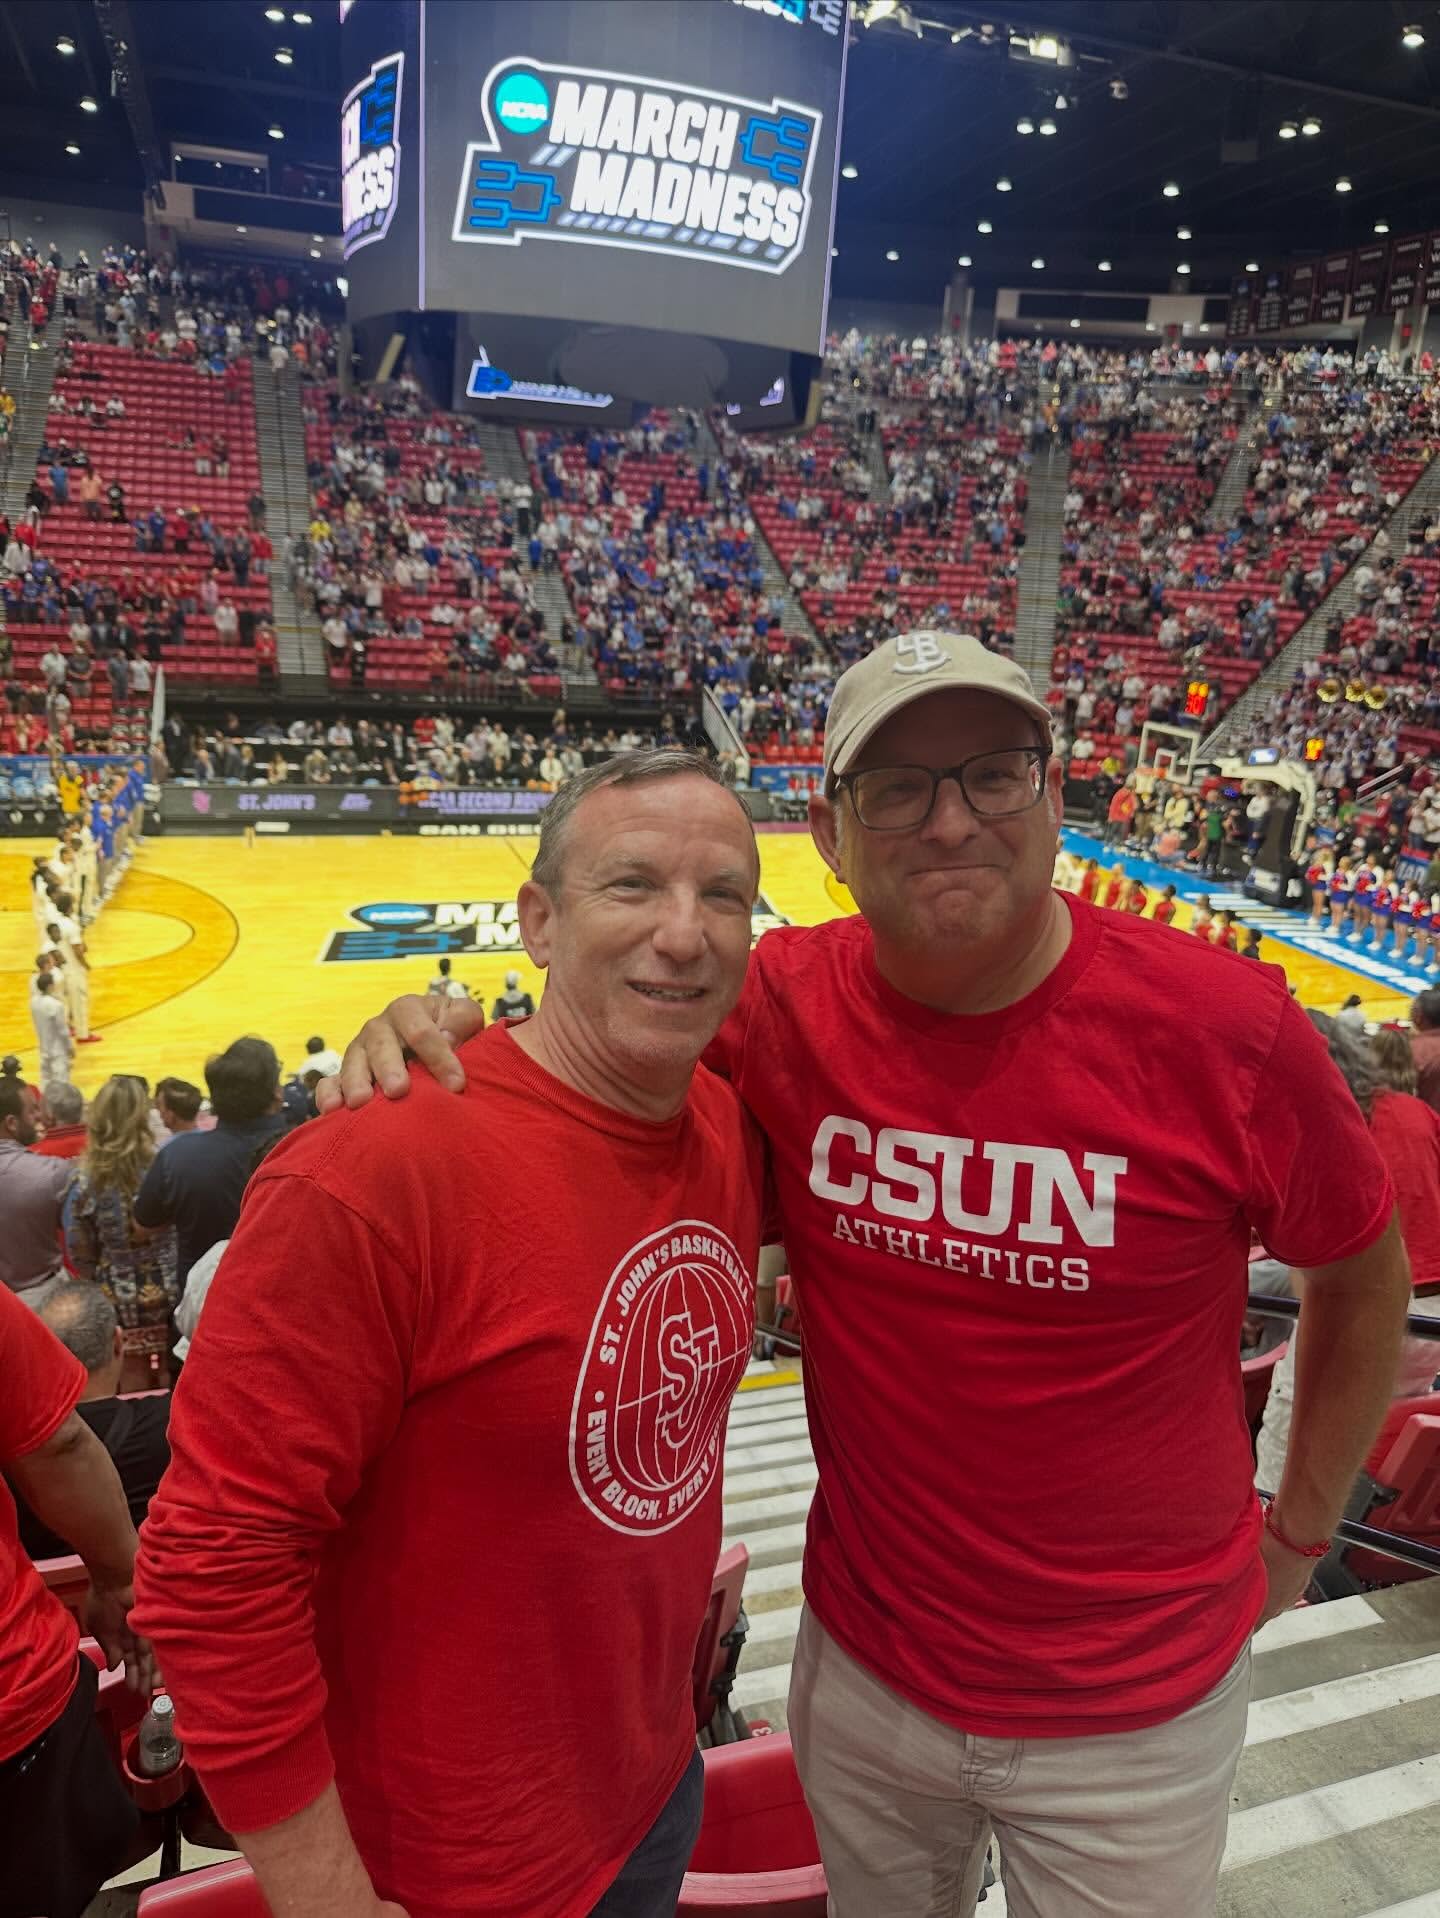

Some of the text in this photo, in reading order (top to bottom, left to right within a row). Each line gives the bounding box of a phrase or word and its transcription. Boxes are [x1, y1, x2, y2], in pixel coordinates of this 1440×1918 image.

[549, 80, 740, 171] MARCH
[569, 150, 803, 248] MADNESS
[237, 793, 316, 810] ST. JOHN'S
[808, 1114, 1128, 1247] CSUN
[600, 1235, 749, 1365] ST. JOHN'S BASKETBALL
[832, 1213, 1090, 1291] ATHLETICS
[586, 1409, 613, 1484] EVERY
[601, 1479, 662, 1520] BLOCK.
[667, 1454, 710, 1515] EVERY
